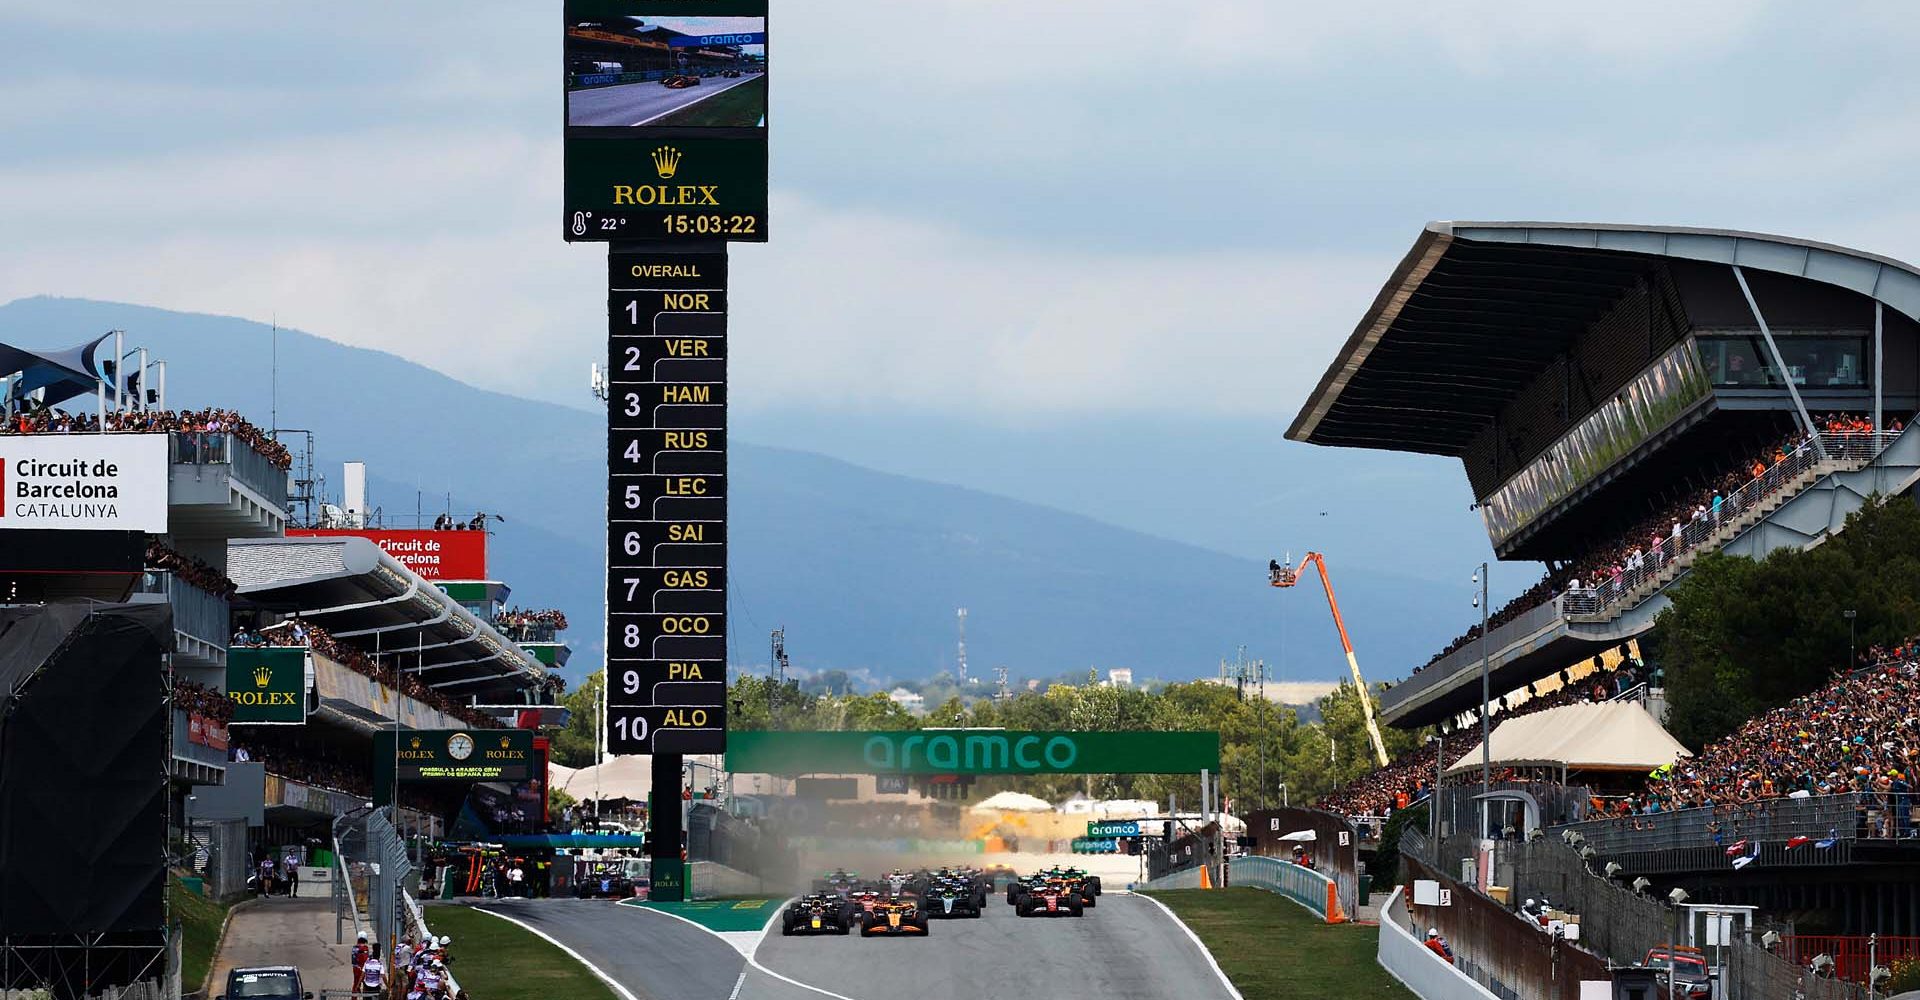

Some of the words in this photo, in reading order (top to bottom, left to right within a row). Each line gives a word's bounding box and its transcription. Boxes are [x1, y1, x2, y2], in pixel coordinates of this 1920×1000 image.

[701, 33, 752, 45] aramco
[613, 185, 720, 205] ROLEX
[663, 215, 756, 233] 15:03:22
[631, 265, 701, 277] OVERALL
[625, 300, 637, 324] 1
[663, 294, 710, 310] NOR
[624, 347, 641, 371] 2
[665, 340, 709, 356] VER
[624, 393, 641, 417] 3
[663, 386, 709, 402] HAM
[623, 440, 641, 463] 4
[664, 432, 708, 448] RUS
[16, 458, 88, 477] Circuit
[92, 459, 118, 477] de
[16, 480, 118, 498] Barcelona
[625, 485, 641, 509] 5
[666, 478, 707, 495] LEC
[15, 503, 118, 517] CATALUNYA
[378, 538, 422, 551] Circuit
[425, 540, 440, 551] de
[624, 531, 641, 555] 6
[668, 525, 703, 541] SAI
[623, 578, 640, 602] 7
[663, 571, 708, 587] GAS
[623, 624, 640, 648] 8
[662, 617, 710, 633] OCO
[623, 670, 640, 694] 9
[668, 663, 703, 679] PIA
[228, 692, 296, 705] ROLEX
[615, 717, 648, 741] 10
[663, 710, 707, 726] ALO
[398, 750, 435, 759] ROLEX
[486, 750, 524, 759] ROLEX
[863, 735, 1077, 769] aramco
[1091, 825, 1135, 835] aramco
[1074, 840, 1112, 849] aramco
